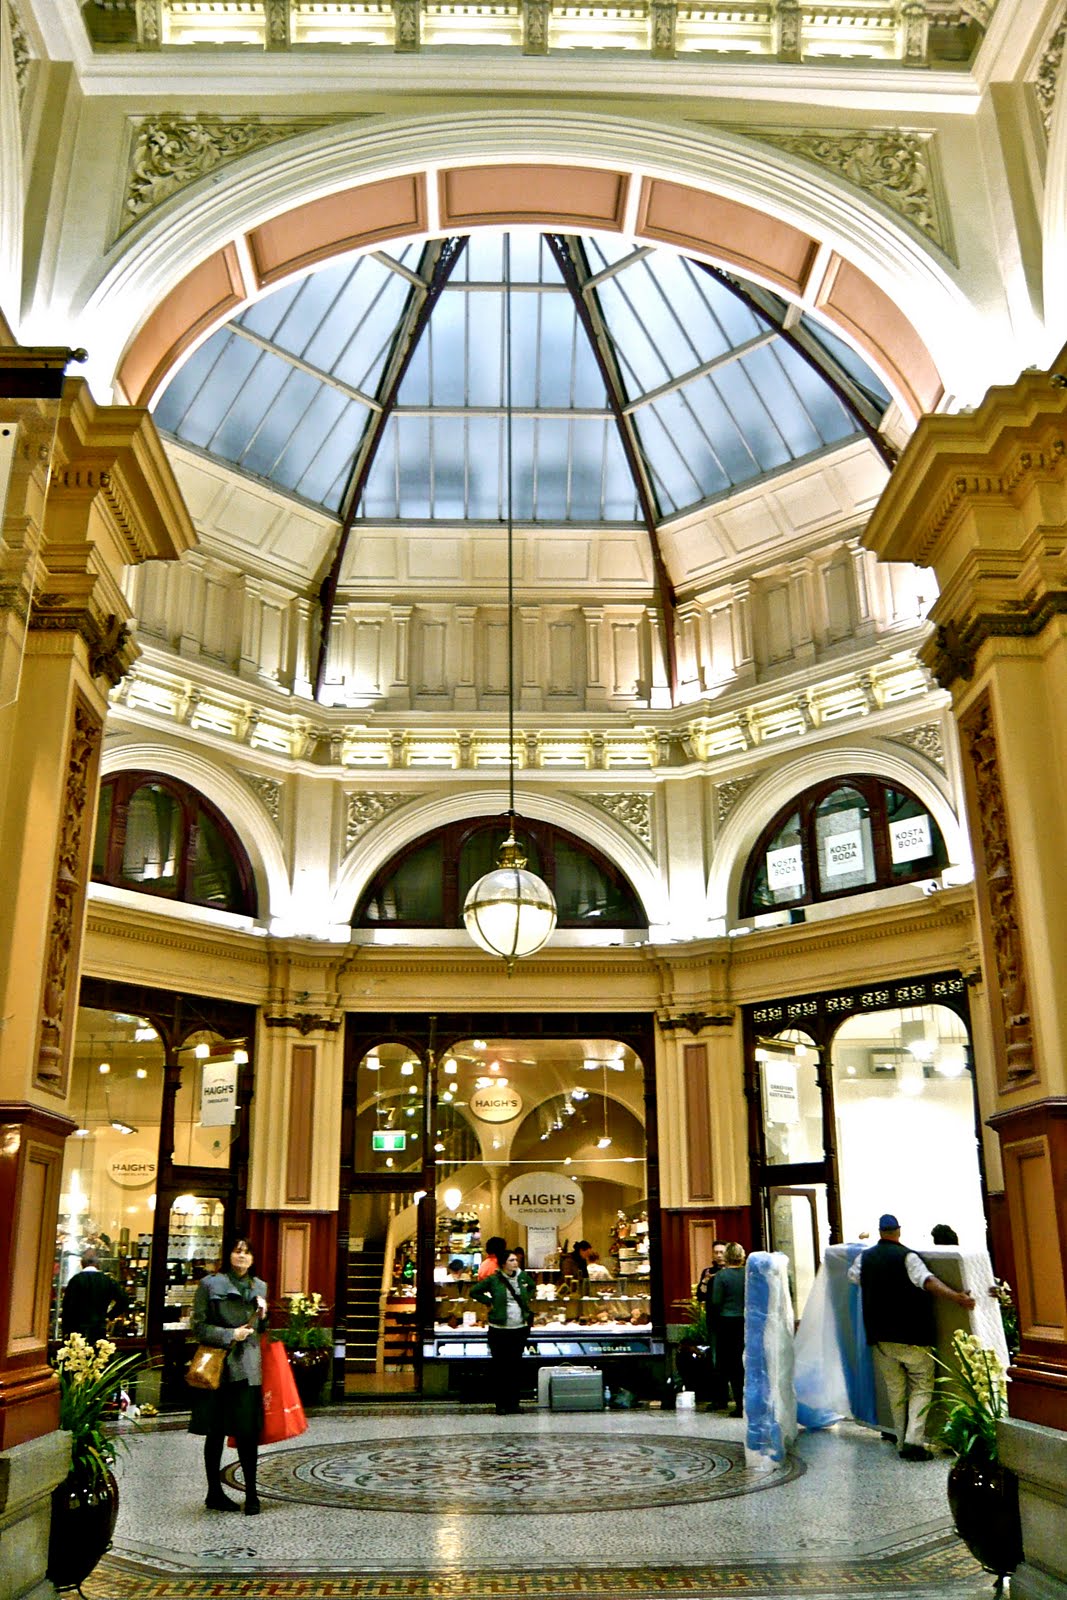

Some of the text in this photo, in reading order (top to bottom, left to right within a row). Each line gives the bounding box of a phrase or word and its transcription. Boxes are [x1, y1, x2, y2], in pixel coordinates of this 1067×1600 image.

[895, 828, 924, 840] KOSTA
[830, 842, 857, 854] KOSTA
[898, 837, 924, 849] BODA
[832, 851, 857, 862] BODA
[772, 857, 797, 868] KOSTA
[204, 1085, 234, 1096] HAIGH'S
[112, 1163, 155, 1171] HAIGH'S
[509, 1194, 576, 1206] HAIGH'S
